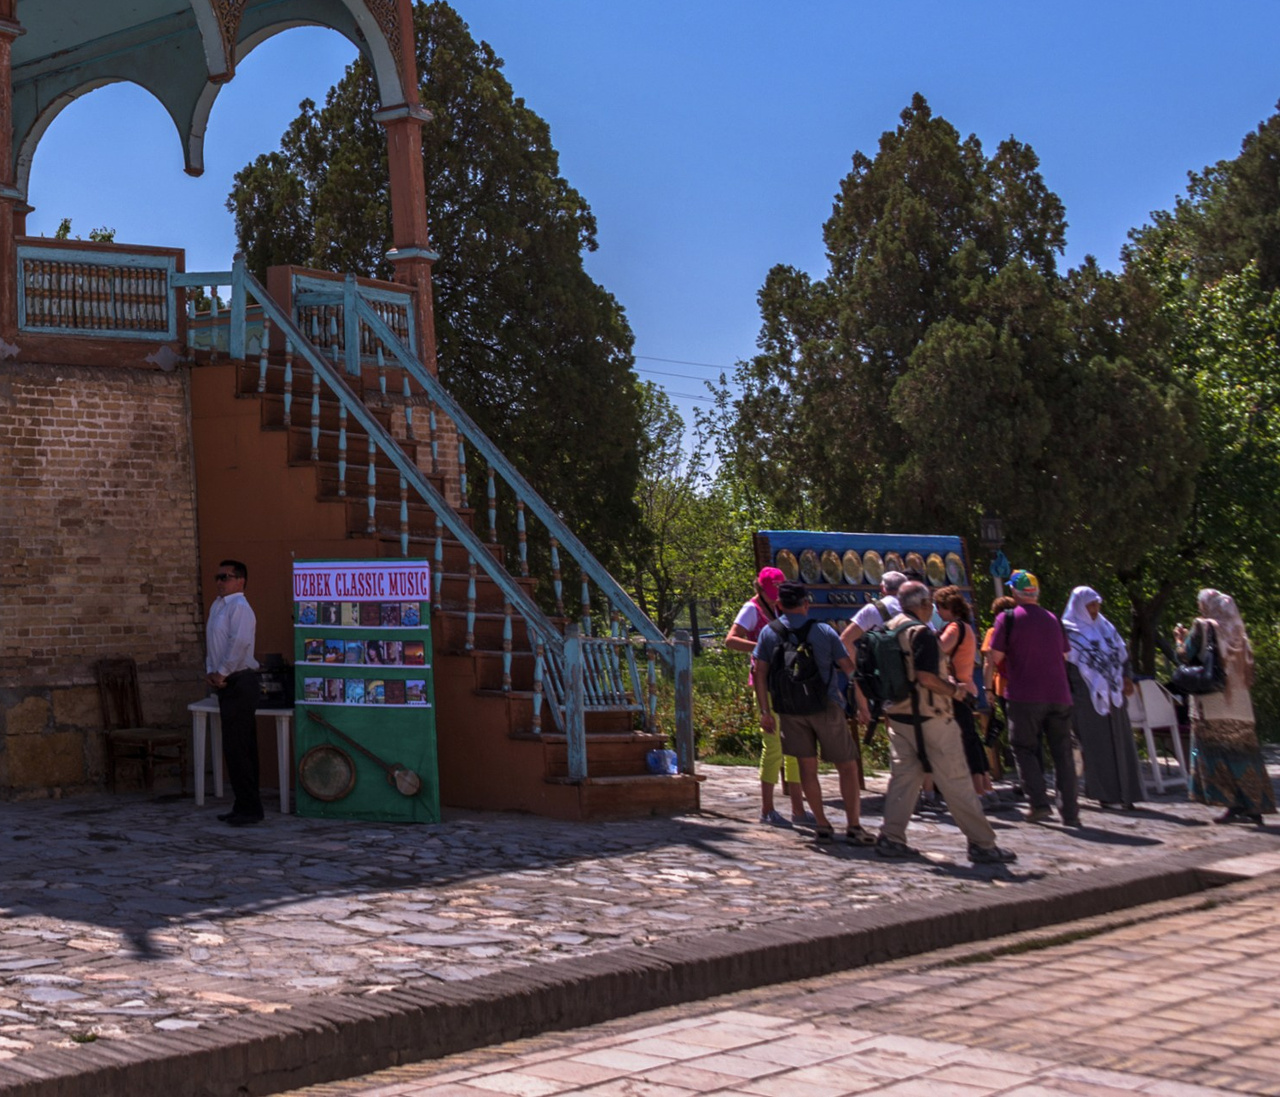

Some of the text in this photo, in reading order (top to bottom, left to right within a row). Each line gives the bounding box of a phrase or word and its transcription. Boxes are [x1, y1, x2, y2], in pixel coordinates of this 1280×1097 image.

[294, 571, 427, 597] UZBEK CLASSIC MUSIC
